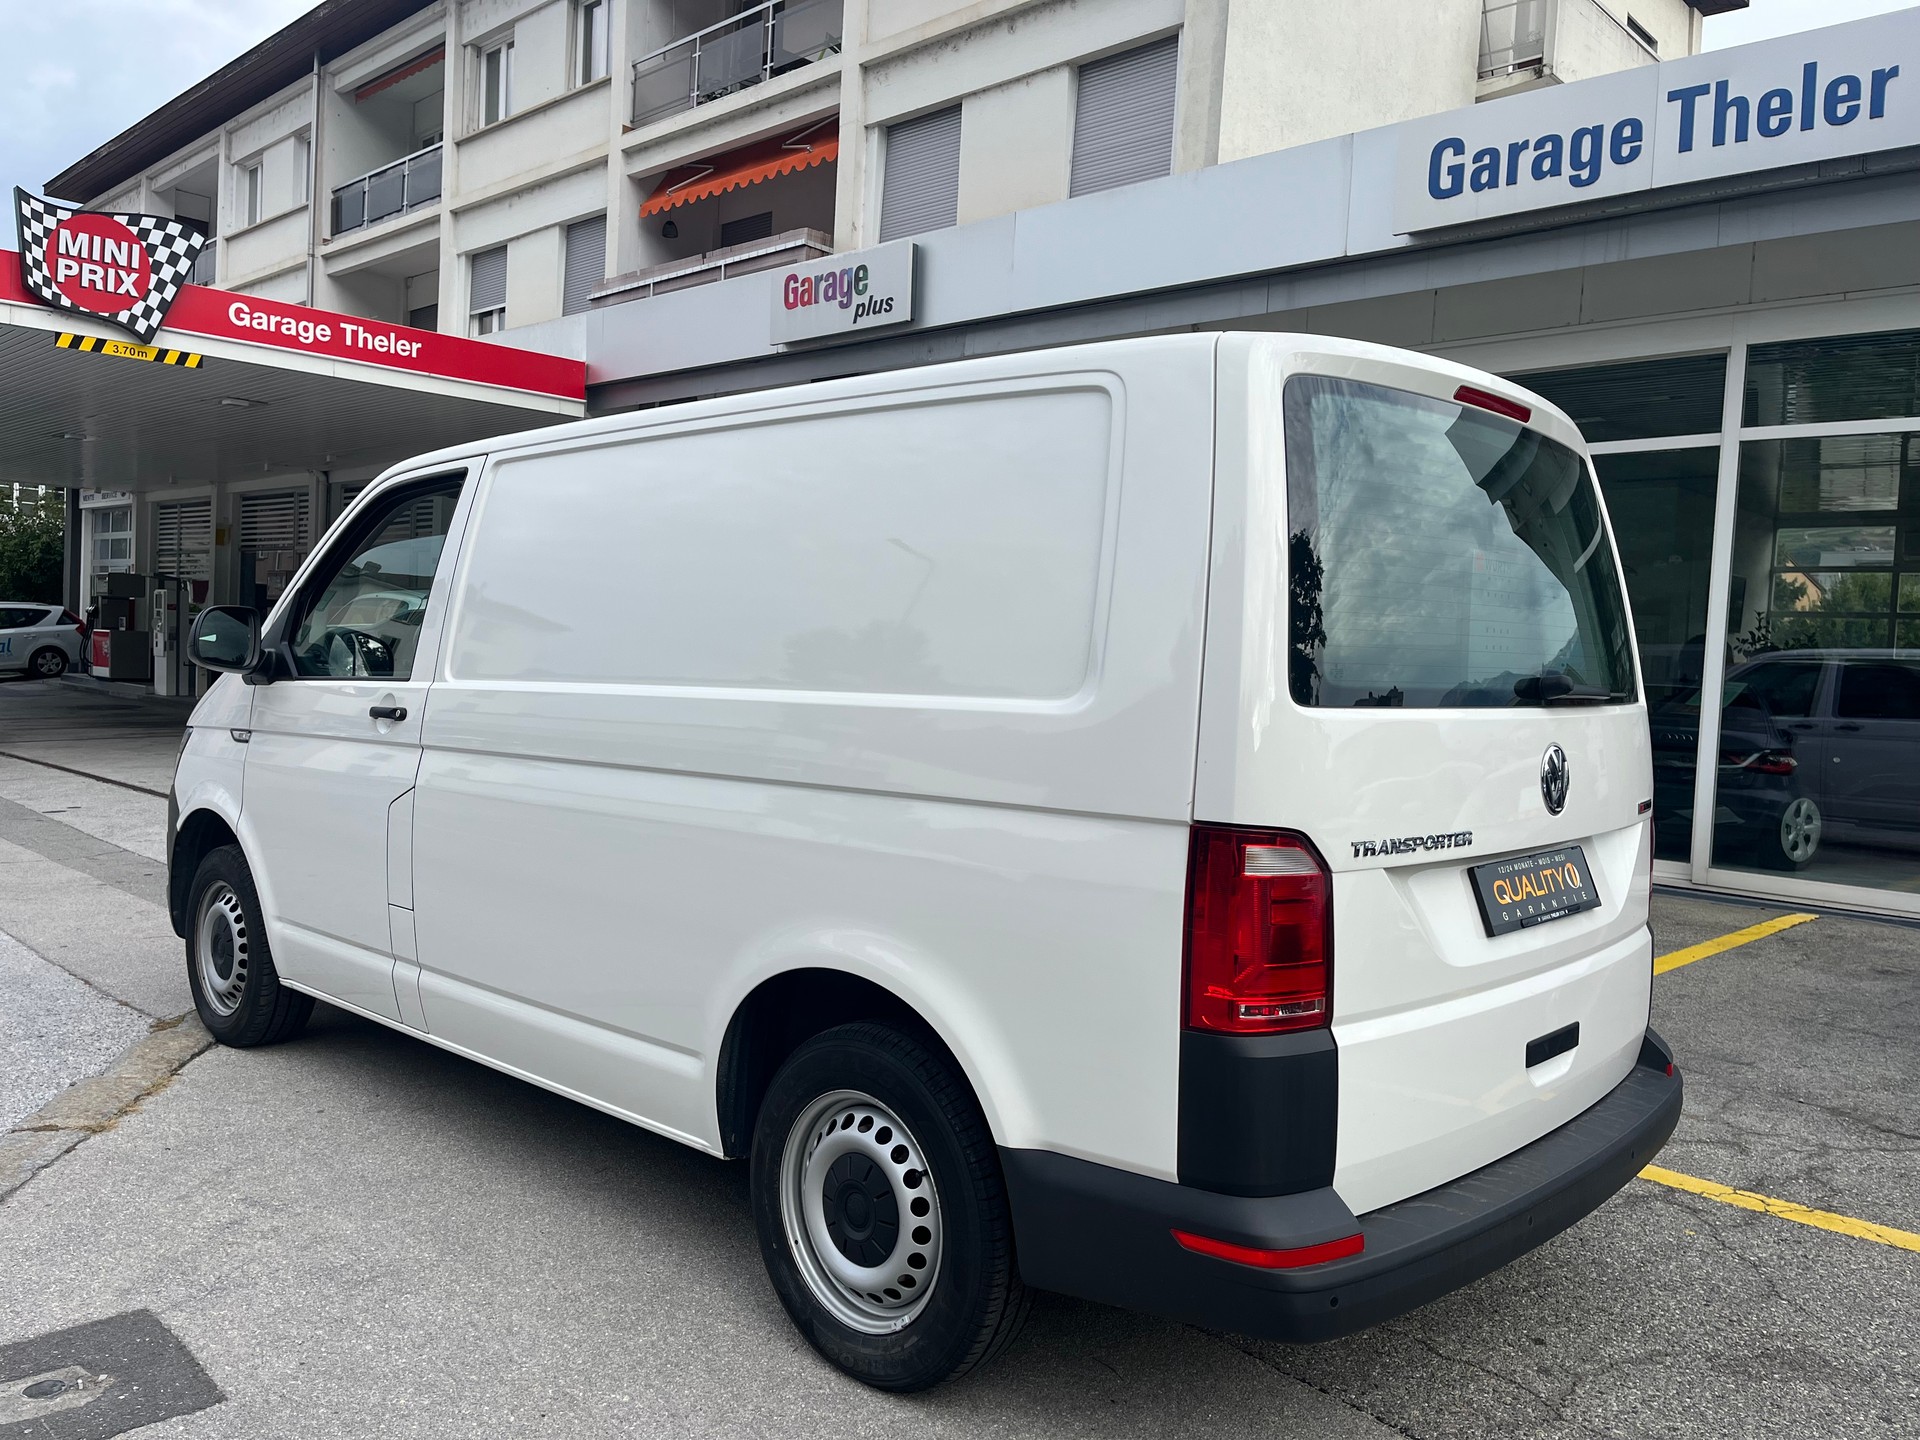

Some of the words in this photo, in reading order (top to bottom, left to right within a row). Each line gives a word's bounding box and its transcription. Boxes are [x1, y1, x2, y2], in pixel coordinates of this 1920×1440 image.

[1428, 118, 1643, 199] Garage
[1667, 61, 1899, 153] Theler
[58, 228, 140, 270] MINI
[56, 258, 140, 297] PRIX
[784, 264, 869, 310] Garage
[852, 295, 894, 324] plus
[228, 302, 331, 344] Garage
[340, 322, 422, 358] Theler
[1351, 831, 1473, 858] TRANSPORTER
[1497, 865, 1513, 874] 12/24
[1513, 860, 1534, 871] MONATE
[1537, 856, 1551, 866] MOIS
[1502, 891, 1588, 921] GARANTIE
